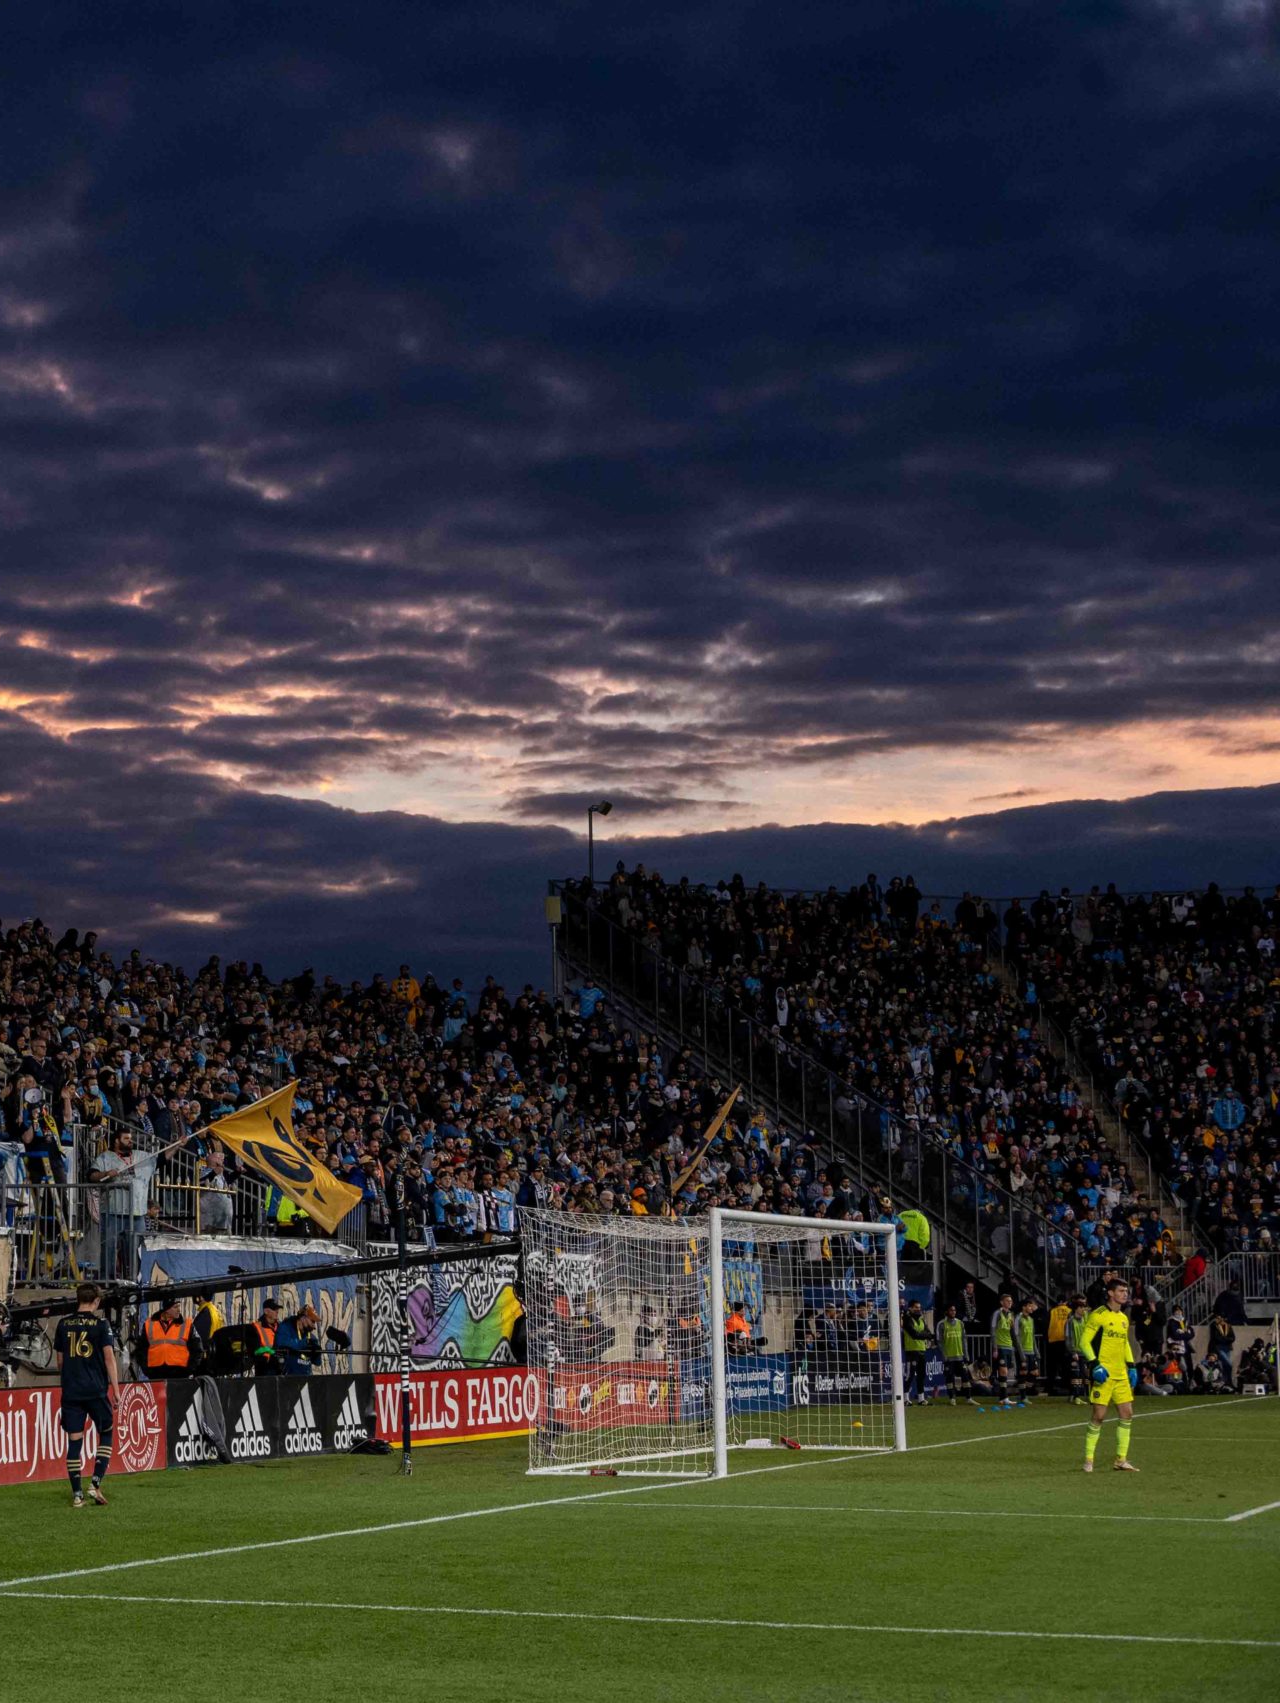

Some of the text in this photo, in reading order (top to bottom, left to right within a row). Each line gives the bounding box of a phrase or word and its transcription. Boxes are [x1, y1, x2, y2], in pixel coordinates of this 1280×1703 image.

[67, 1331, 93, 1358] 16
[792, 1367, 810, 1405] rts
[375, 1378, 459, 1434] WELLS
[466, 1373, 540, 1427] FARGO
[231, 1431, 270, 1458] adidas
[285, 1427, 322, 1454] adidas
